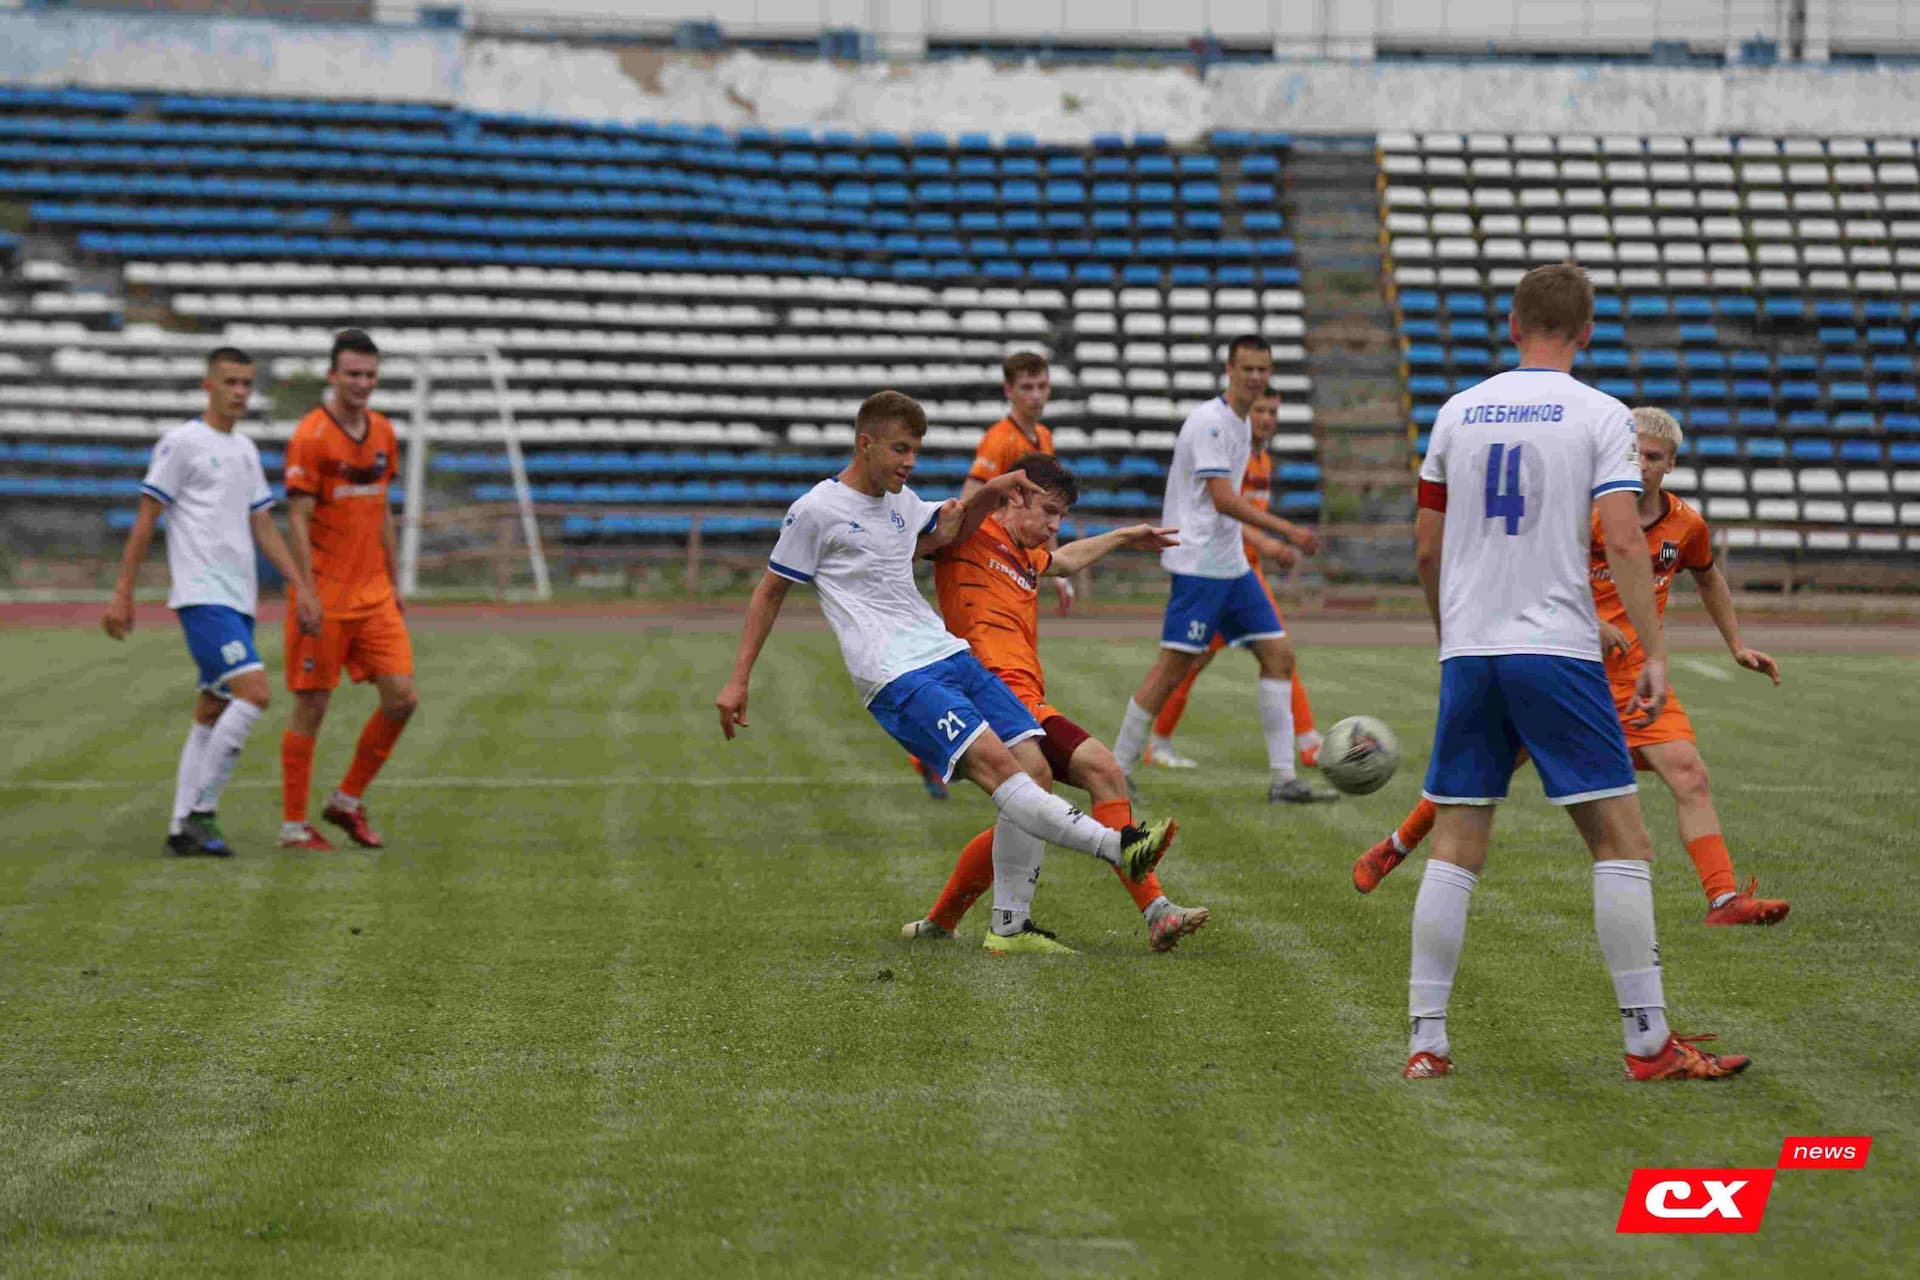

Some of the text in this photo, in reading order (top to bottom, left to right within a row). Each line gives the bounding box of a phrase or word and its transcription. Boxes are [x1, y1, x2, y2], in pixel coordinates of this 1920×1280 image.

[1463, 404, 1564, 425] ХЛЕБНИКОВ
[1485, 443, 1525, 535] 4
[937, 710, 966, 741] 21
